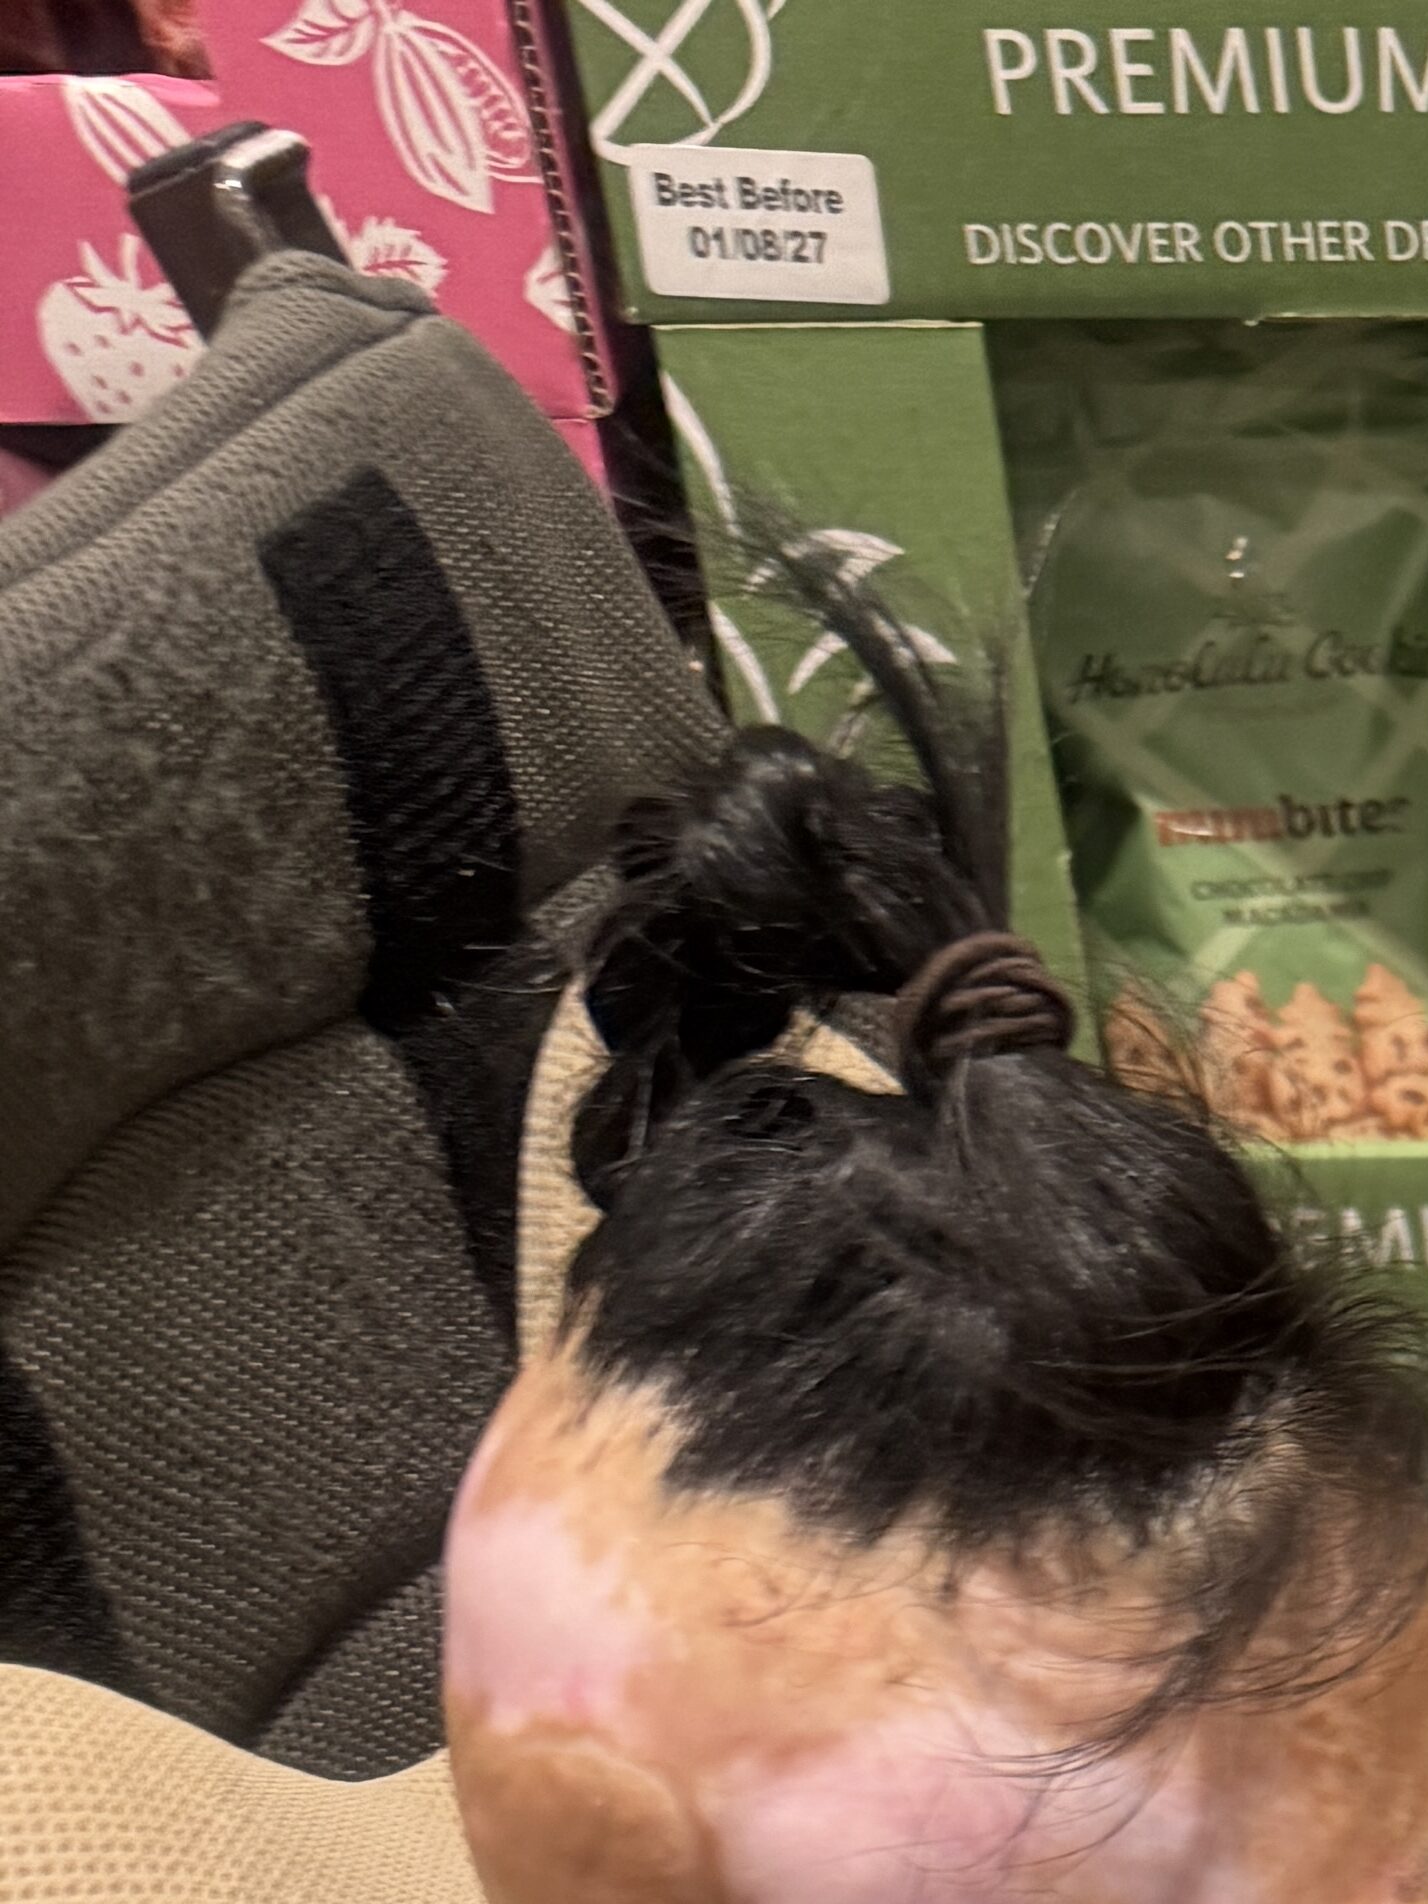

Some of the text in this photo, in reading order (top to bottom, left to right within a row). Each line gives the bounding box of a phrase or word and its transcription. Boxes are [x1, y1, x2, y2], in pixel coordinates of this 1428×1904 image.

[653, 174, 845, 215] Best Before
[688, 226, 828, 264] 01/08/27
[963, 222, 1203, 266] DISCOVER
[1213, 219, 1375, 265] OTHER
